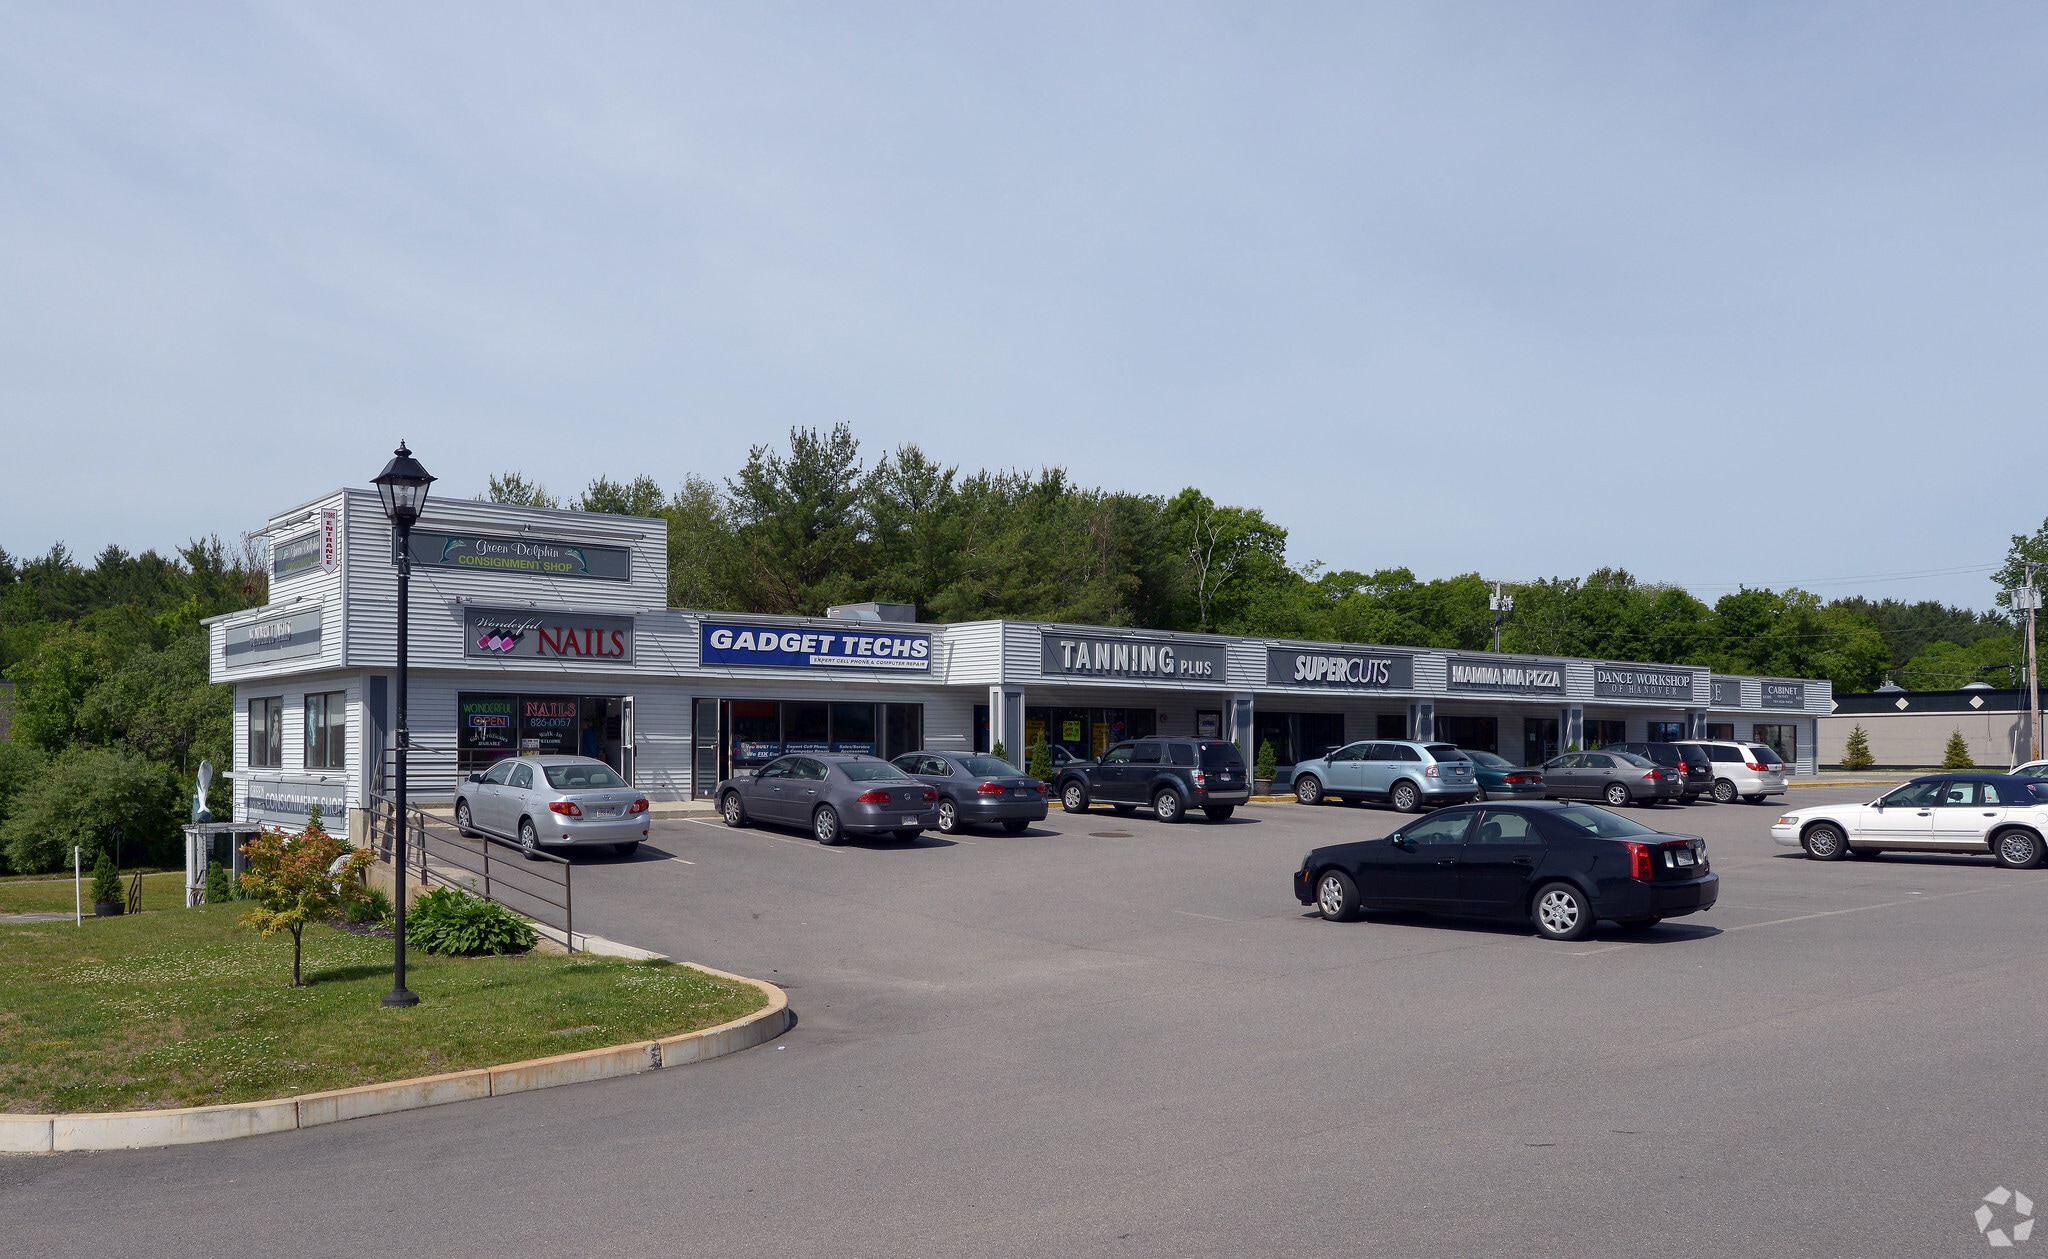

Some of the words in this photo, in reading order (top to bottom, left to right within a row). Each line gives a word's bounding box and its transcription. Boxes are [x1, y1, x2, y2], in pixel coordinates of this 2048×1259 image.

[323, 511, 336, 519] STORE
[325, 520, 333, 565] ENTRANCE
[475, 539, 508, 556] Green
[511, 542, 559, 559] Dolphin
[458, 555, 541, 570] CONSIGNMENT
[543, 561, 573, 572] SHOP
[474, 617, 543, 636] Wonderful
[536, 626, 625, 657] NAILS
[710, 629, 836, 654] GADGET
[842, 636, 929, 658] TECHS
[1060, 641, 1175, 674] TANNING
[1180, 660, 1212, 675] PLUS
[1294, 655, 1390, 684] SUPERCUTS
[1452, 665, 1501, 685] MAMMA
[1502, 668, 1525, 686] MIA
[1526, 669, 1561, 687] PIZZA
[1597, 671, 1633, 684] DANCE
[1636, 673, 1690, 687] WORKSHOP
[1611, 684, 1623, 693] OF
[1629, 685, 1677, 695] HANOVER
[1768, 685, 1798, 695] CABINET
[463, 703, 512, 714] WONDERFUL
[525, 702, 577, 717] NAILS
[473, 716, 506, 726] OPEN
[530, 718, 571, 727] 826-0057
[265, 792, 318, 815] CONSIGNMENT
[320, 796, 344, 816] SHOP
